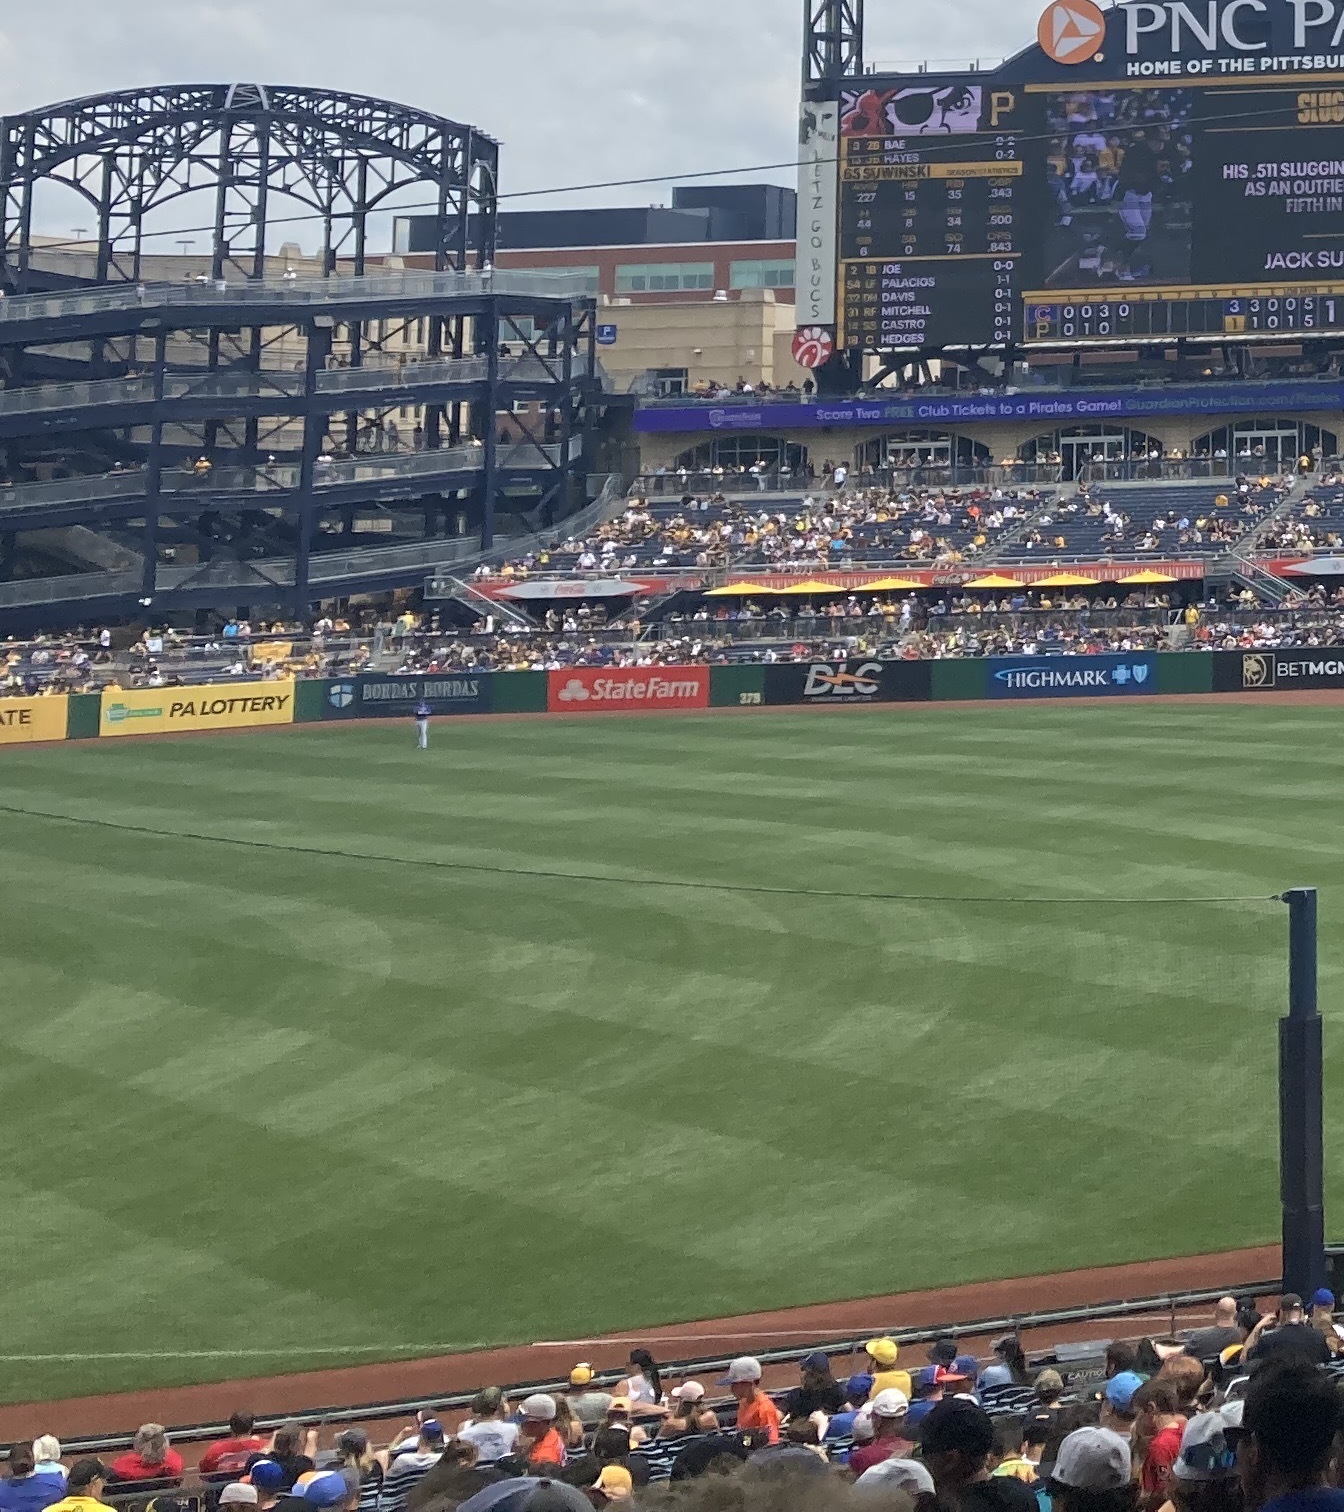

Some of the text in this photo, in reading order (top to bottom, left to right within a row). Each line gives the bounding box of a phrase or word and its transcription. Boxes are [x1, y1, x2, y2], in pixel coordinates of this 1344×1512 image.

[1126, 60, 1182, 76] HOME
[1187, 58, 1213, 74] OF
[1217, 57, 1255, 72] THE
[990, 91, 1015, 127] P
[1297, 92, 1344, 123] SLUG
[884, 140, 906, 150] BAE
[884, 153, 920, 164] HAYES
[995, 150, 1015, 160] 0-2
[1222, 164, 1249, 179] HIS
[1252, 162, 1277, 178] .511
[812, 150, 824, 210] LETZ
[1244, 181, 1267, 196] AS
[1268, 180, 1291, 196] AN
[905, 191, 916, 201] 15
[948, 190, 962, 200] 35
[1286, 196, 1324, 213] FIFTH
[1326, 196, 1343, 212] IN
[857, 220, 872, 229] 44
[947, 217, 961, 226] 34
[811, 220, 822, 249] GO
[905, 245, 913, 255] 0
[947, 244, 961, 254] 74
[882, 264, 901, 274] JOE
[993, 260, 1014, 270] 0-0
[1264, 251, 1315, 270] JACK
[810, 258, 822, 319] BUCS
[881, 274, 1010, 289] PALACIOS 1-1
[881, 288, 1012, 302] DAVIS 0-1
[881, 302, 1012, 317] MITCHELL 0-1
[1063, 297, 1314, 319] 0 0 3 0 3 3 0 0 5
[881, 316, 1012, 330] CASTRO 0-1
[1063, 323, 1074, 336] 0
[1099, 322, 1110, 335] 0
[1267, 315, 1278, 329] 0
[1304, 315, 1314, 328] 5
[881, 333, 925, 344] HEDGES
[994, 330, 1011, 341] 0-1
[816, 409, 853, 420] Score
[855, 407, 881, 419] Two
[918, 404, 949, 417] Club
[952, 403, 996, 416] Tickets
[1000, 403, 1013, 415] to
[1016, 405, 1025, 414] a
[1028, 401, 1072, 414] Pirates
[1076, 399, 1122, 413] Game!
[803, 665, 883, 695] DLC
[1007, 669, 1107, 688] HIGHMARK
[362, 680, 478, 700] BORDAS BORDAS
[170, 702, 195, 718] PA
[200, 695, 290, 716] LOTTERY
